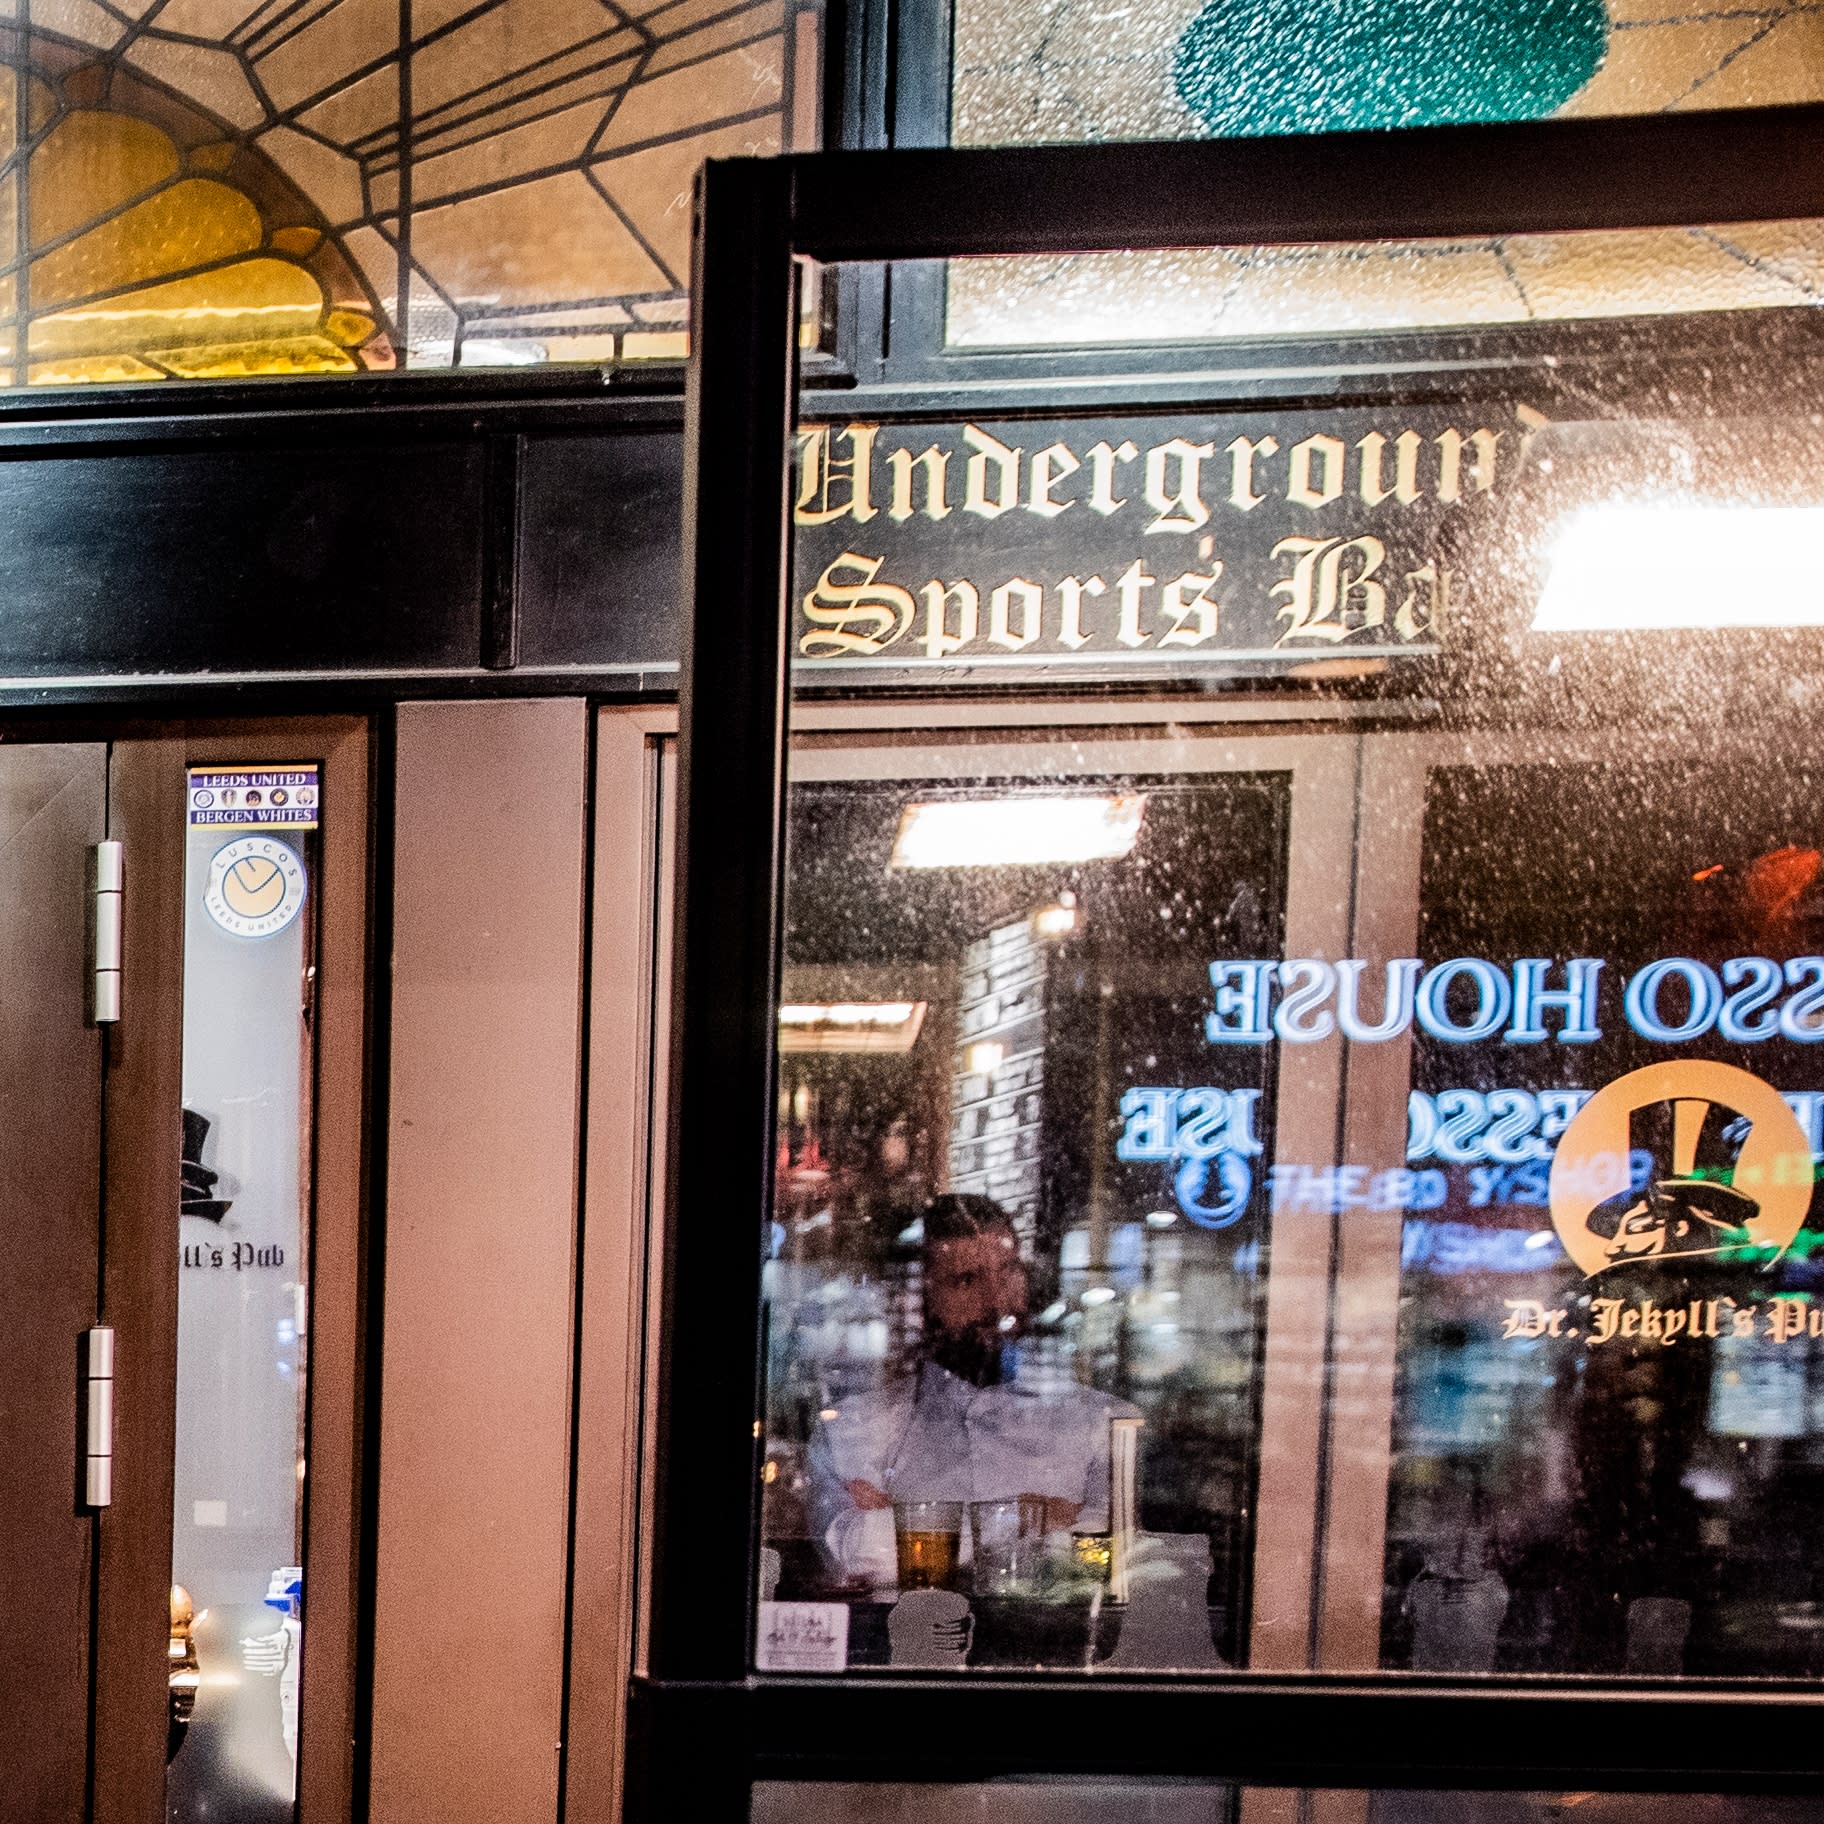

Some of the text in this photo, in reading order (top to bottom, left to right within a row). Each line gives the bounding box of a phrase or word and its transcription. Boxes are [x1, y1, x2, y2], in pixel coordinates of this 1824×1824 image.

[1269, 534, 1451, 650] Ba
[202, 773, 307, 788] LEEDS UNITED
[196, 808, 312, 824] BERGEN WHITES
[232, 1242, 284, 1271] Pub
[1502, 1298, 1579, 1339] Dr.
